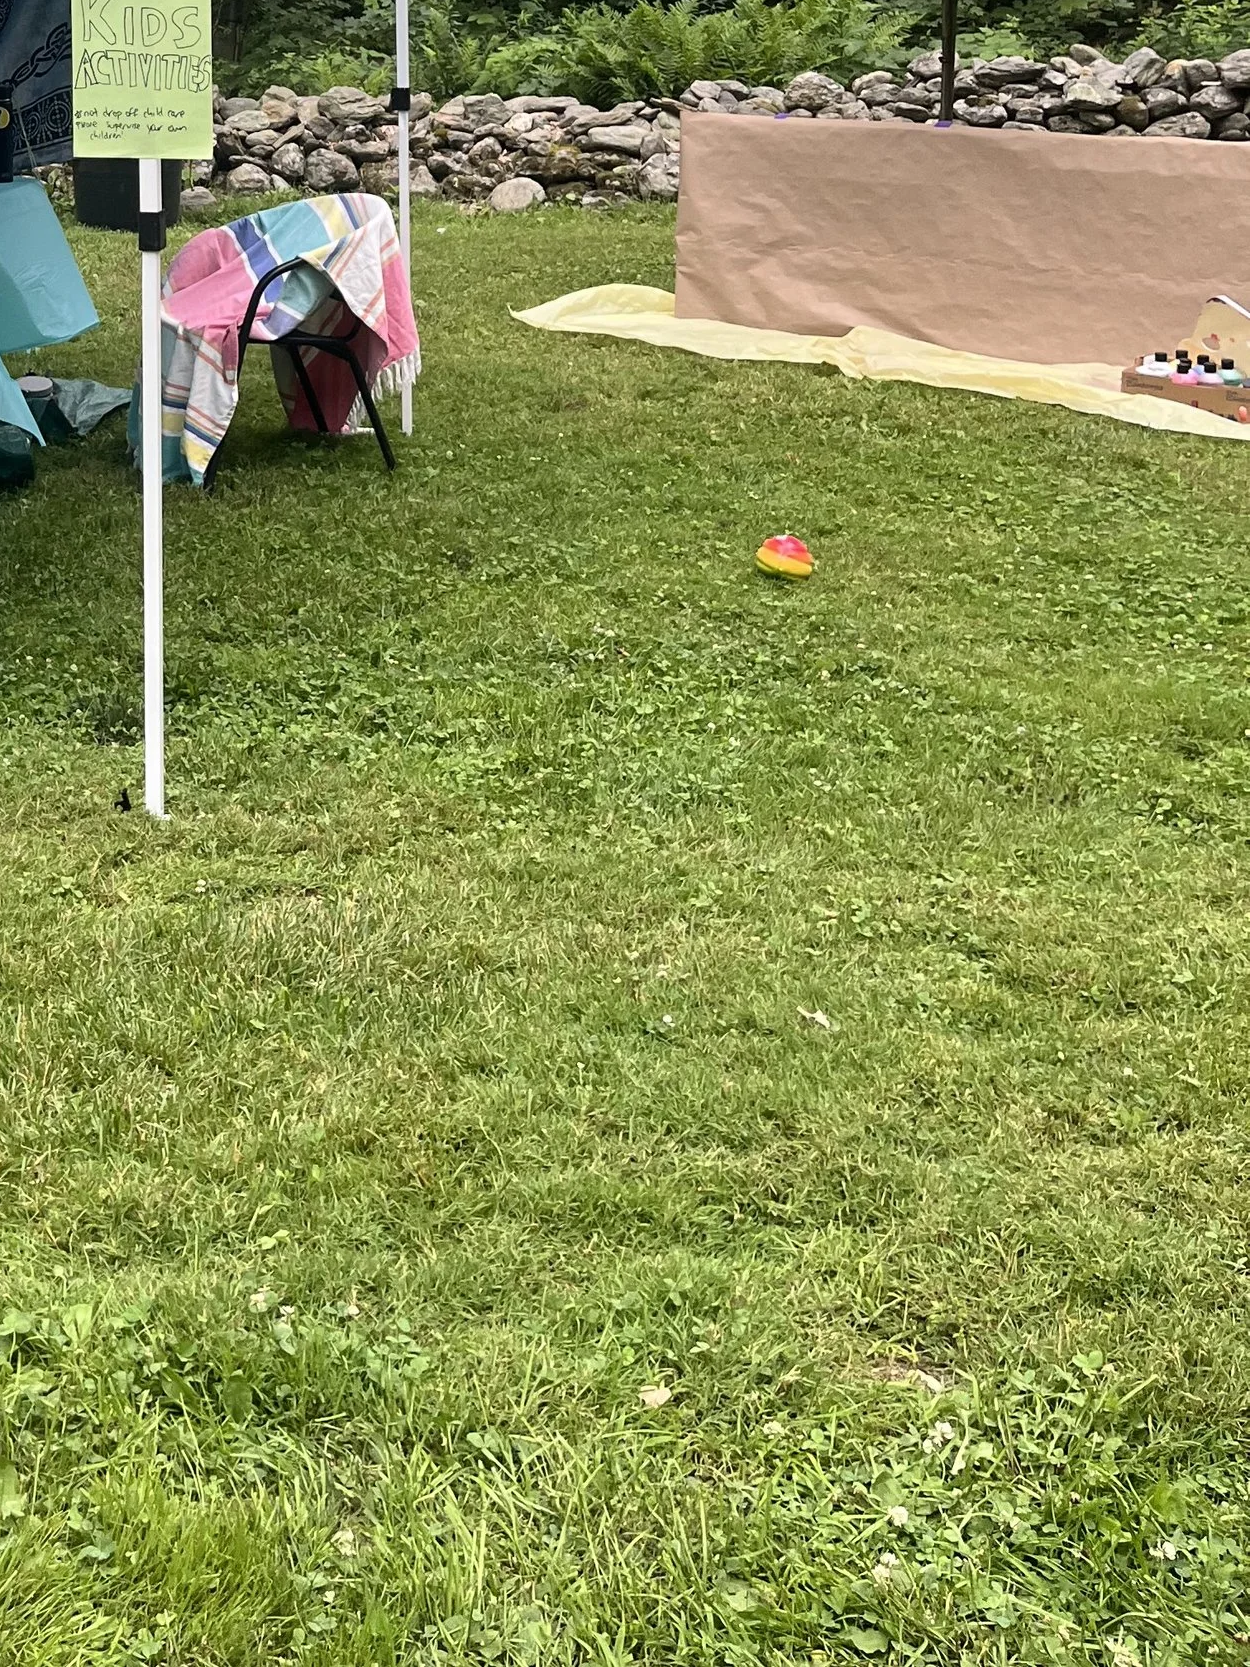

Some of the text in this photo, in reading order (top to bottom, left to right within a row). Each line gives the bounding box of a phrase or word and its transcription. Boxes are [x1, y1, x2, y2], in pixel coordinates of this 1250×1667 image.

[74, 48, 213, 93] ACTIVITIES
[103, 107, 122, 120] drop
[125, 107, 139, 118] off
[144, 107, 163, 118] child
[168, 109, 185, 118] care
[147, 124, 163, 134] your
